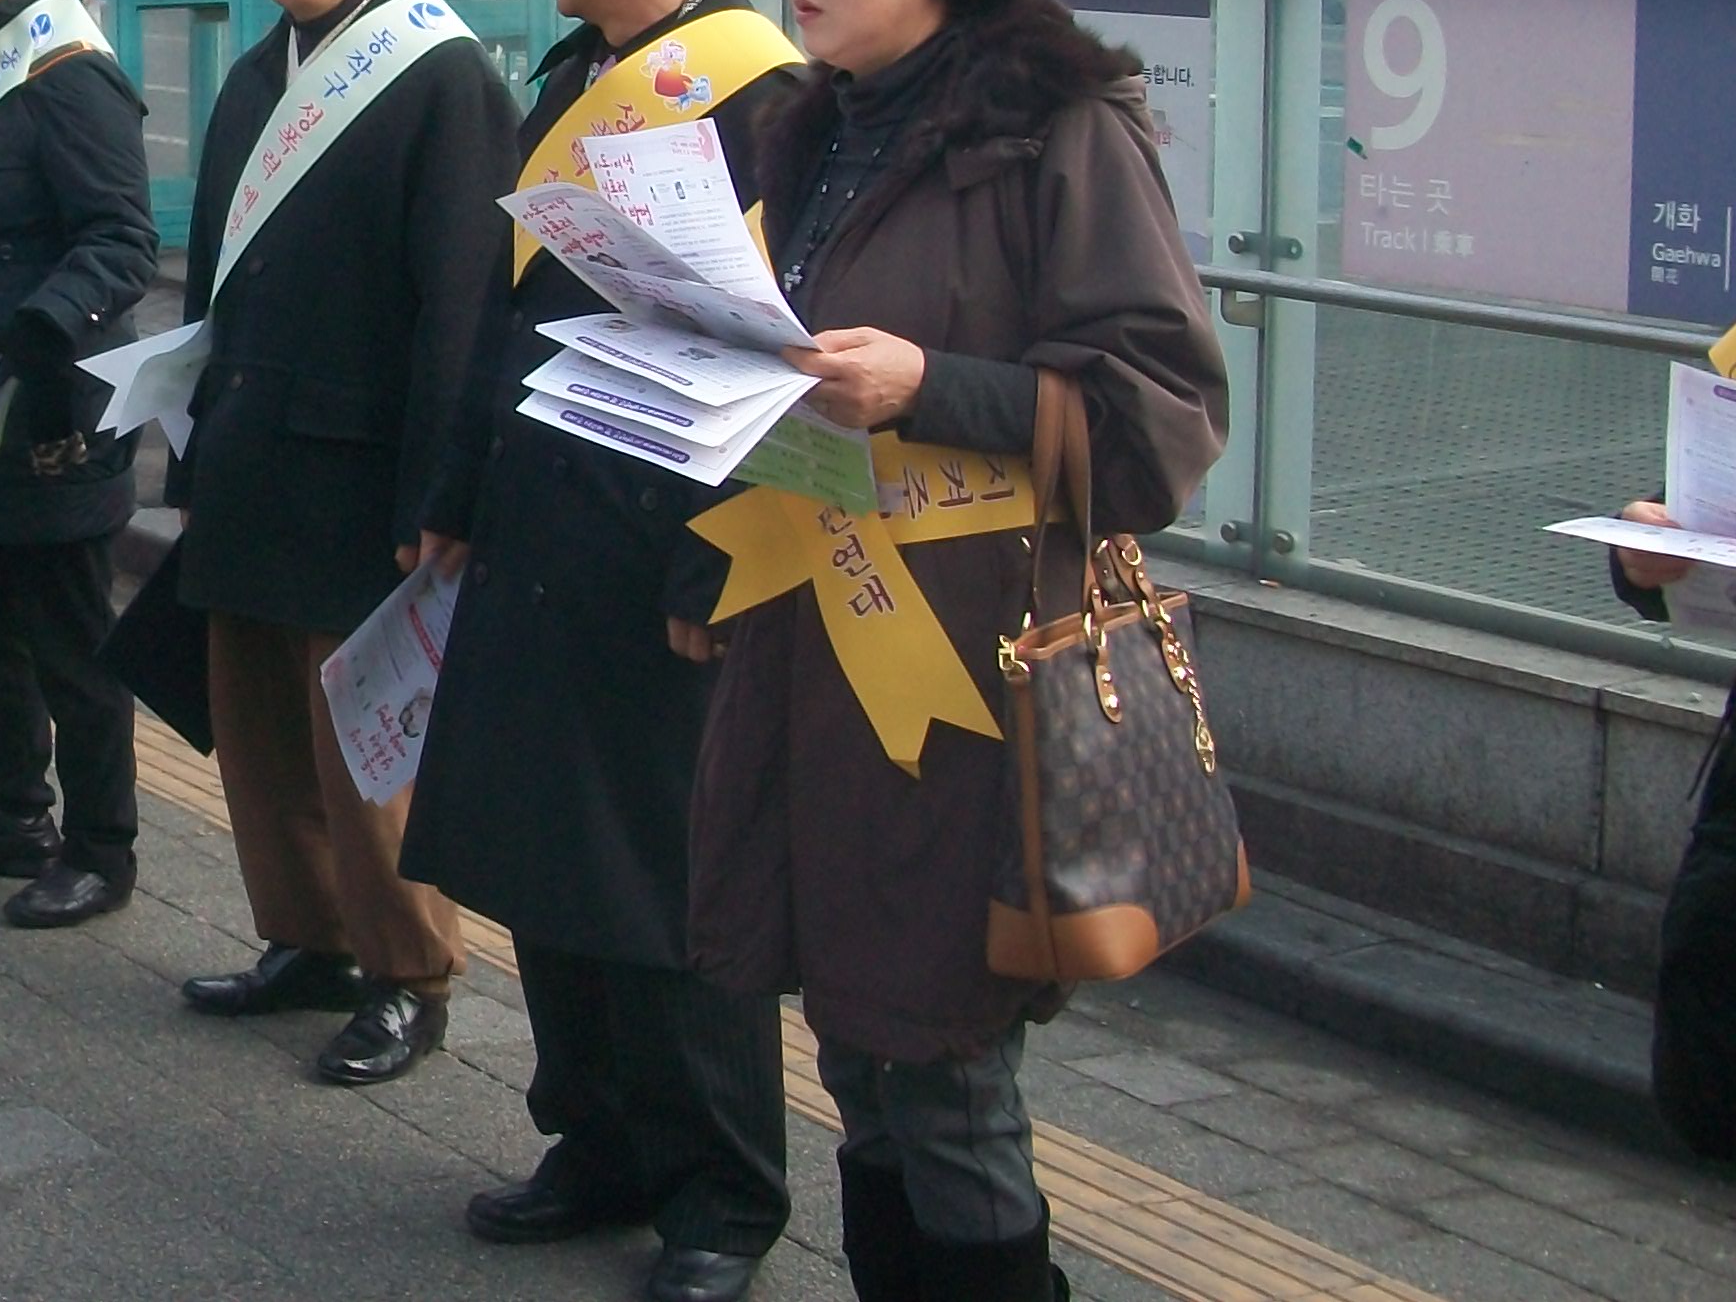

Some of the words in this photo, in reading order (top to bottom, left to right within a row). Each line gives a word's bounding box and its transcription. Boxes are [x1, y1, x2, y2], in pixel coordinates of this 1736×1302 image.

[323, 27, 399, 100] 동작구
[263, 101, 325, 181] 성폭력
[1360, 173, 1416, 208] 타는
[1426, 179, 1453, 216] 곳
[1652, 201, 1702, 234] 개화
[1360, 221, 1417, 253] Track
[1652, 242, 1721, 268] Gaehwa
